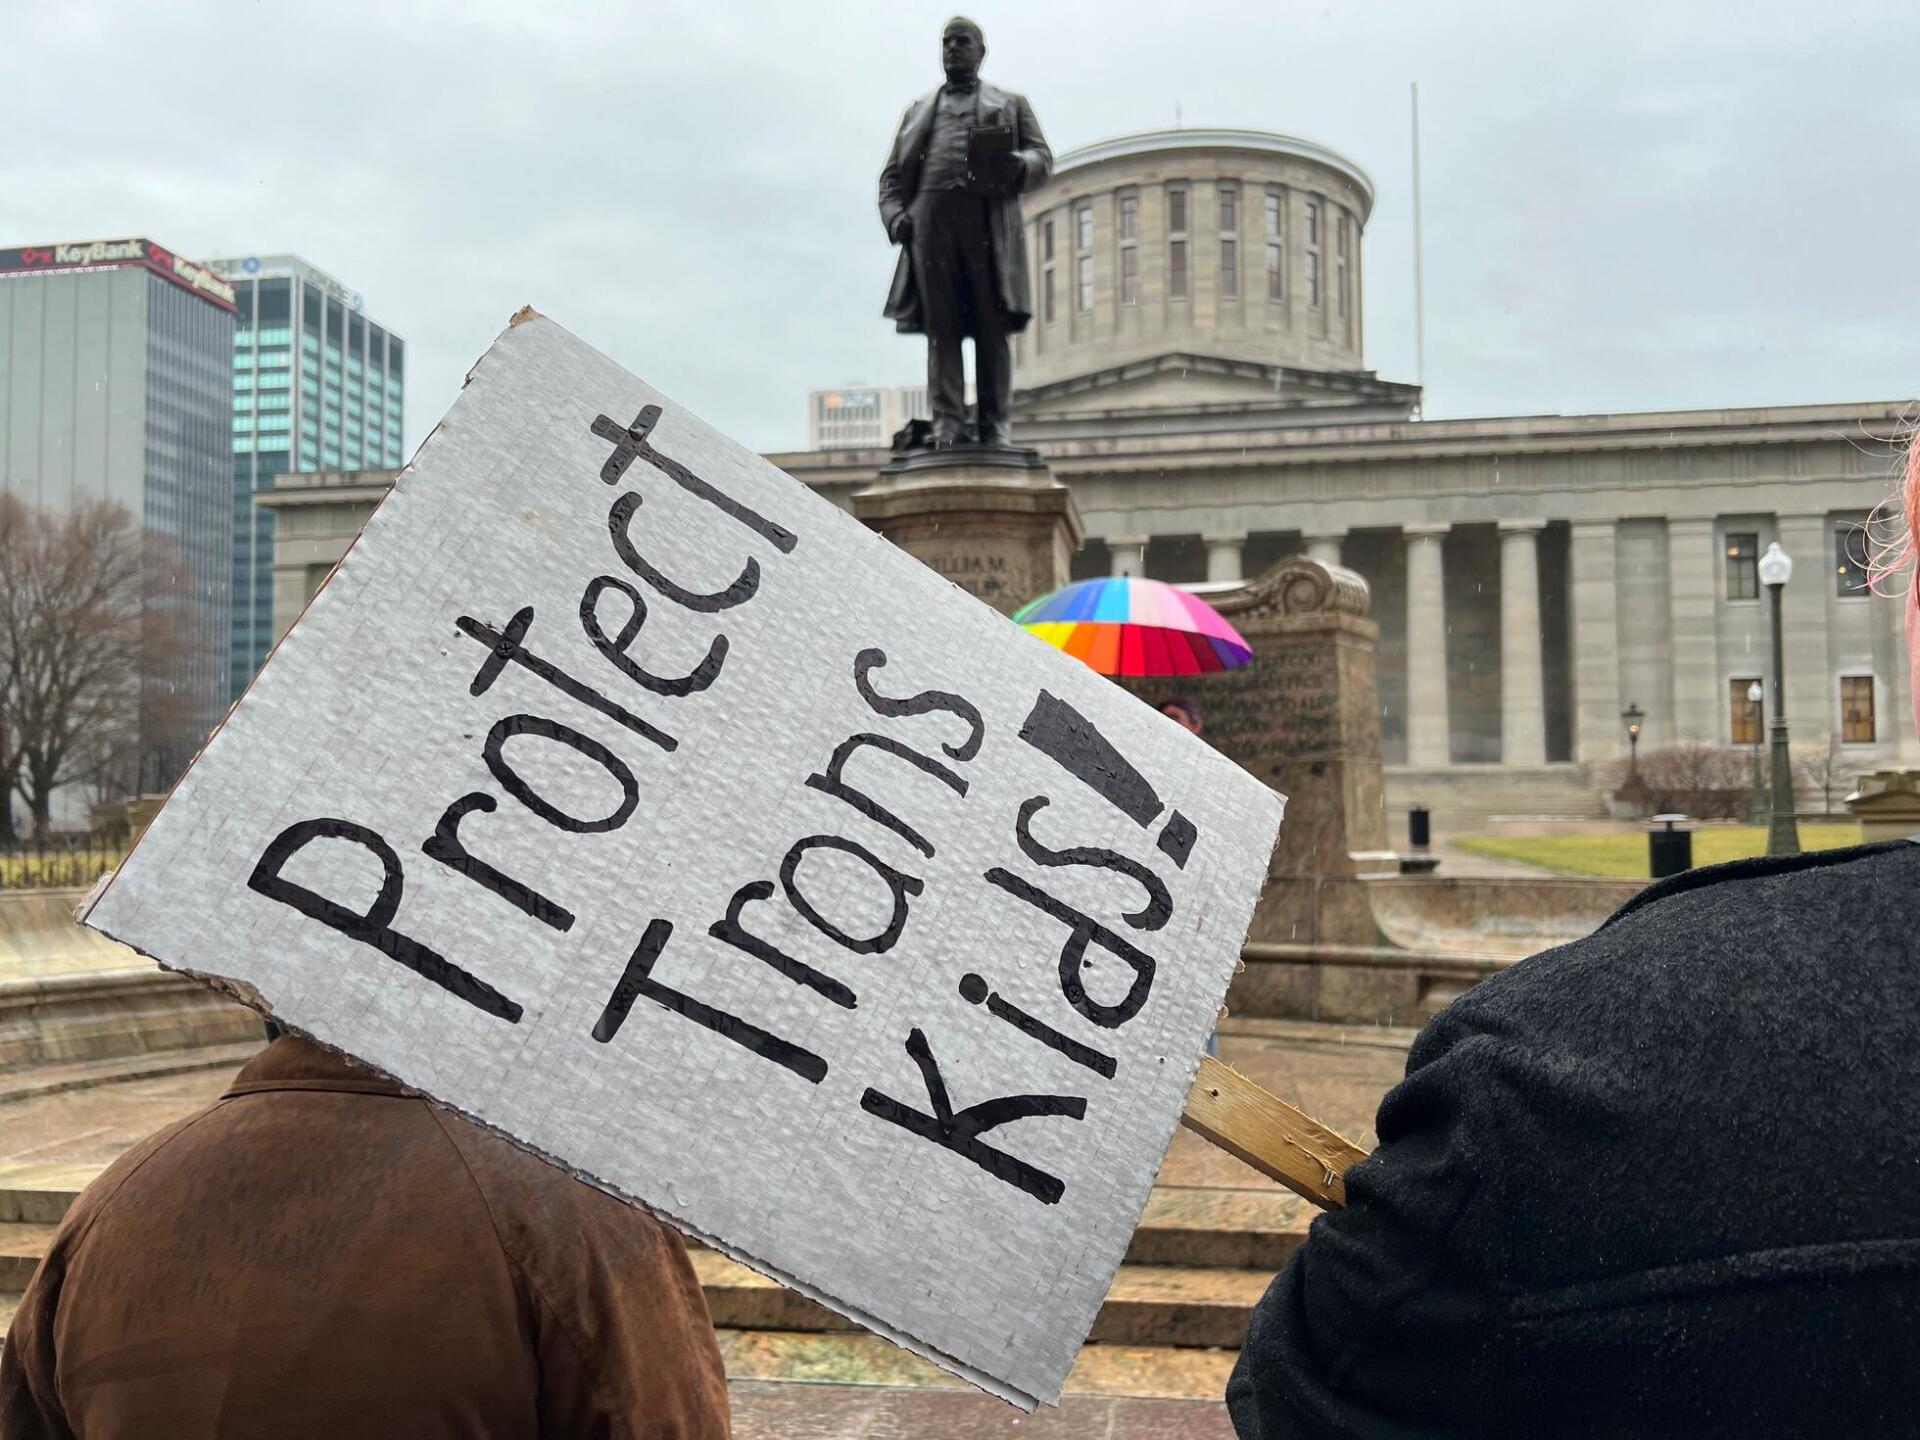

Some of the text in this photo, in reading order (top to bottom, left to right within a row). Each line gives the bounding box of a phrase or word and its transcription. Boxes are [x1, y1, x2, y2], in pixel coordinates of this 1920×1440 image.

[55, 240, 143, 265] KeyBank
[247, 406, 797, 1024] Protect
[592, 649, 984, 1084] Trans
[860, 690, 1197, 1205] Kids!
